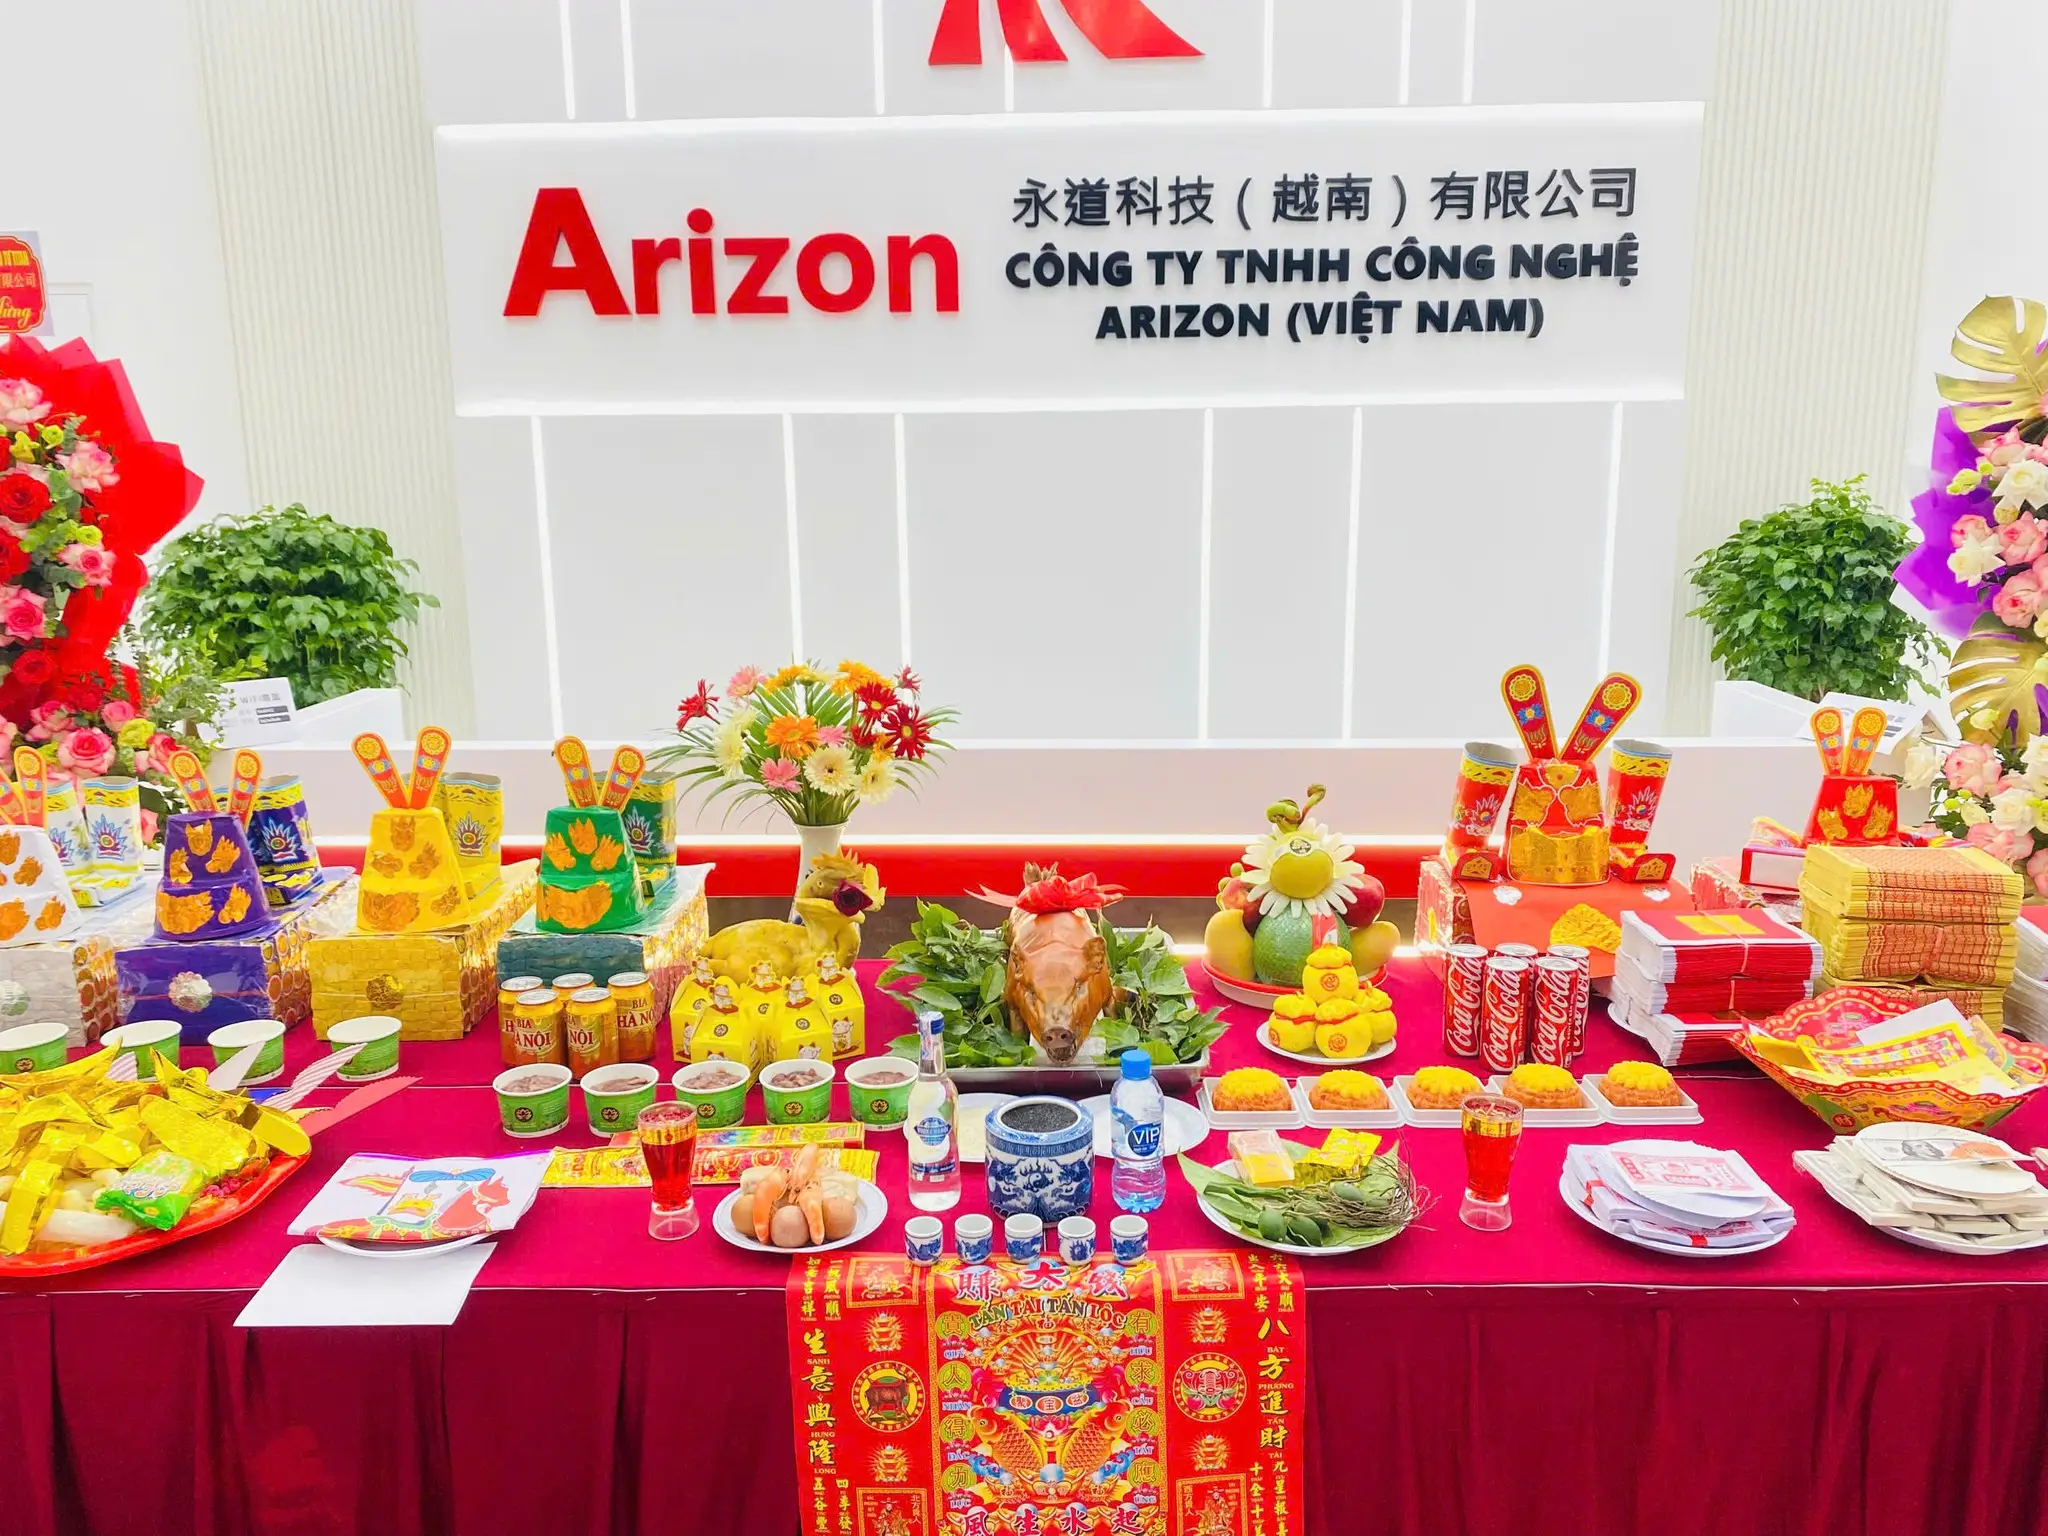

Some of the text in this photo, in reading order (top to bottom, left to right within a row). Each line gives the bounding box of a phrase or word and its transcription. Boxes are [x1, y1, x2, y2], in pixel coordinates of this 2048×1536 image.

[503, 187, 959, 316] Arizon
[1005, 232, 1639, 288] CÔNG TY TNHH CÔNG NGHỆ
[1095, 291, 1544, 344] ARIZON (VIỆT NAM)
[632, 998, 648, 1009] BIA
[517, 1018, 532, 1029] BIA
[617, 1011, 638, 1028] HÀ
[523, 1030, 551, 1051] NỘI
[569, 1028, 594, 1049] NỘI
[1132, 1127, 1160, 1145] VIP
[1010, 1296, 1044, 1315] TÀI
[1088, 1301, 1126, 1328] LỘC
